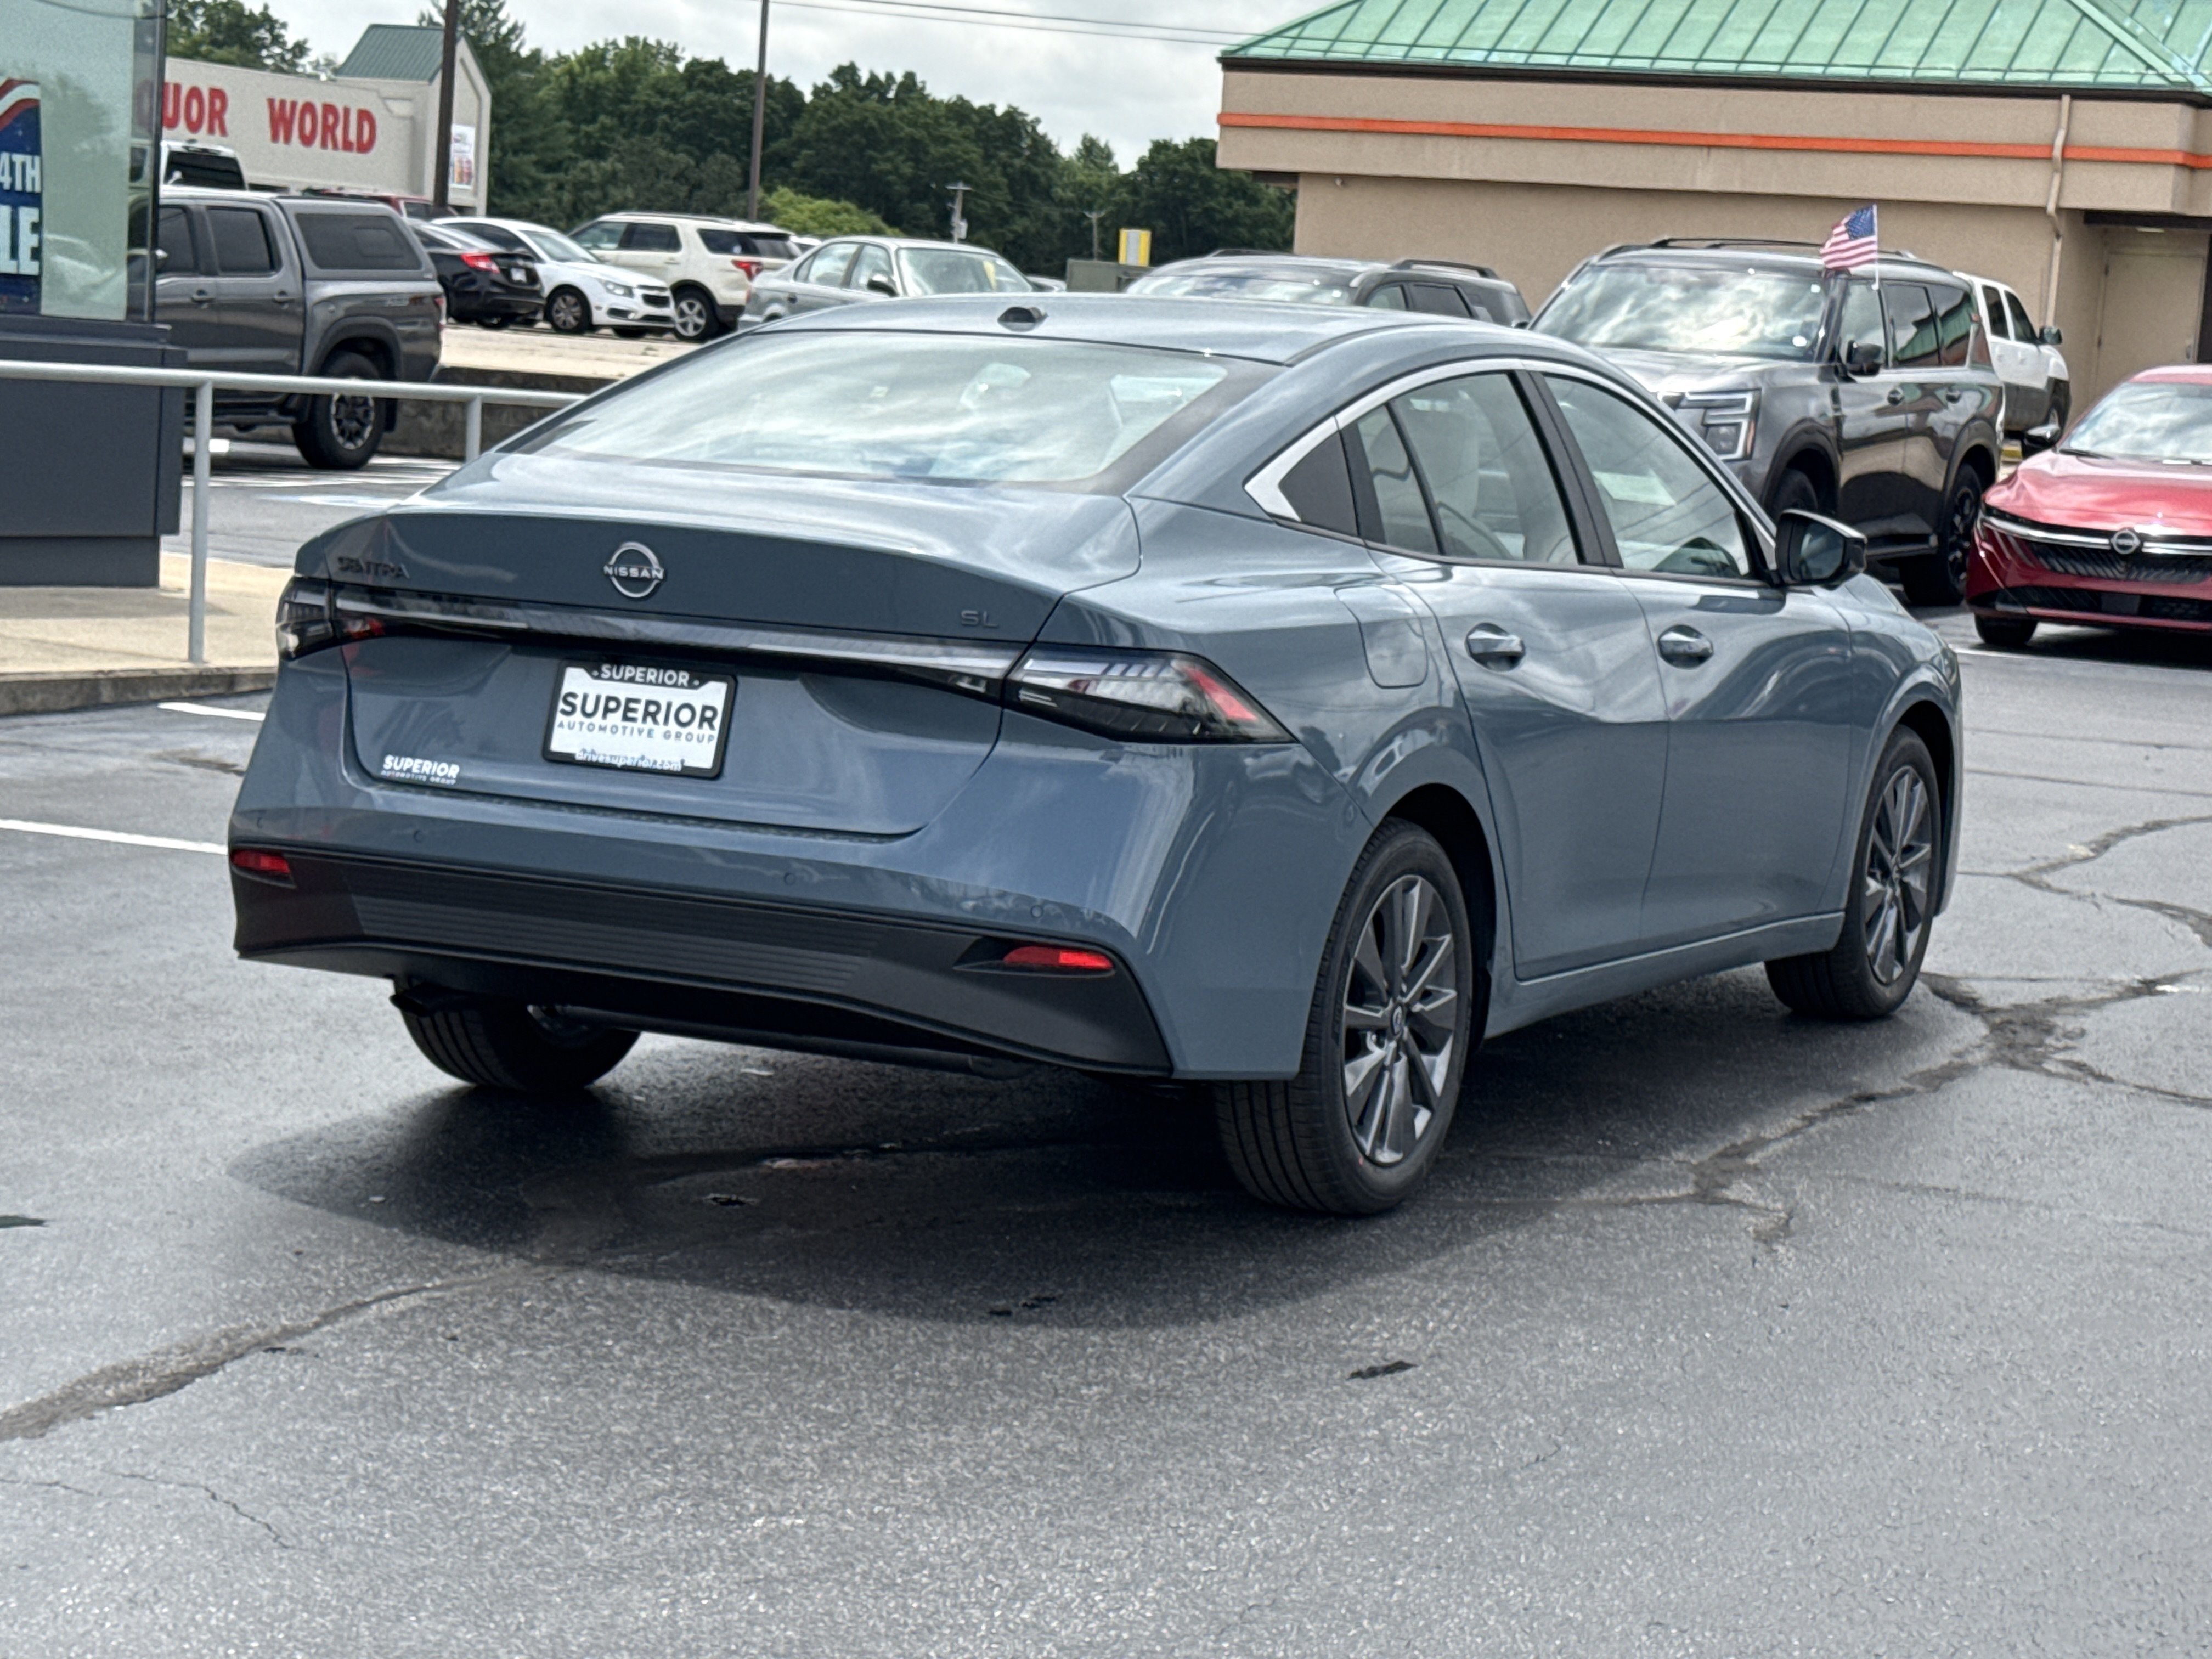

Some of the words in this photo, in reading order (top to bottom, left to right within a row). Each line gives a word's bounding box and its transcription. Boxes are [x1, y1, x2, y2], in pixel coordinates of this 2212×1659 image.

[267, 98, 376, 154] WORLD
[0, 151, 41, 193] 4TH
[337, 556, 410, 579] SENTRA
[603, 565, 664, 580] NISSAN
[961, 610, 999, 627] SL
[601, 663, 690, 686] SUPERIOR
[559, 692, 719, 731] SUPERIOR
[557, 720, 656, 738] AUTOMOTIVE
[663, 730, 715, 744] GROUP
[383, 754, 460, 778] SUPERIOR
